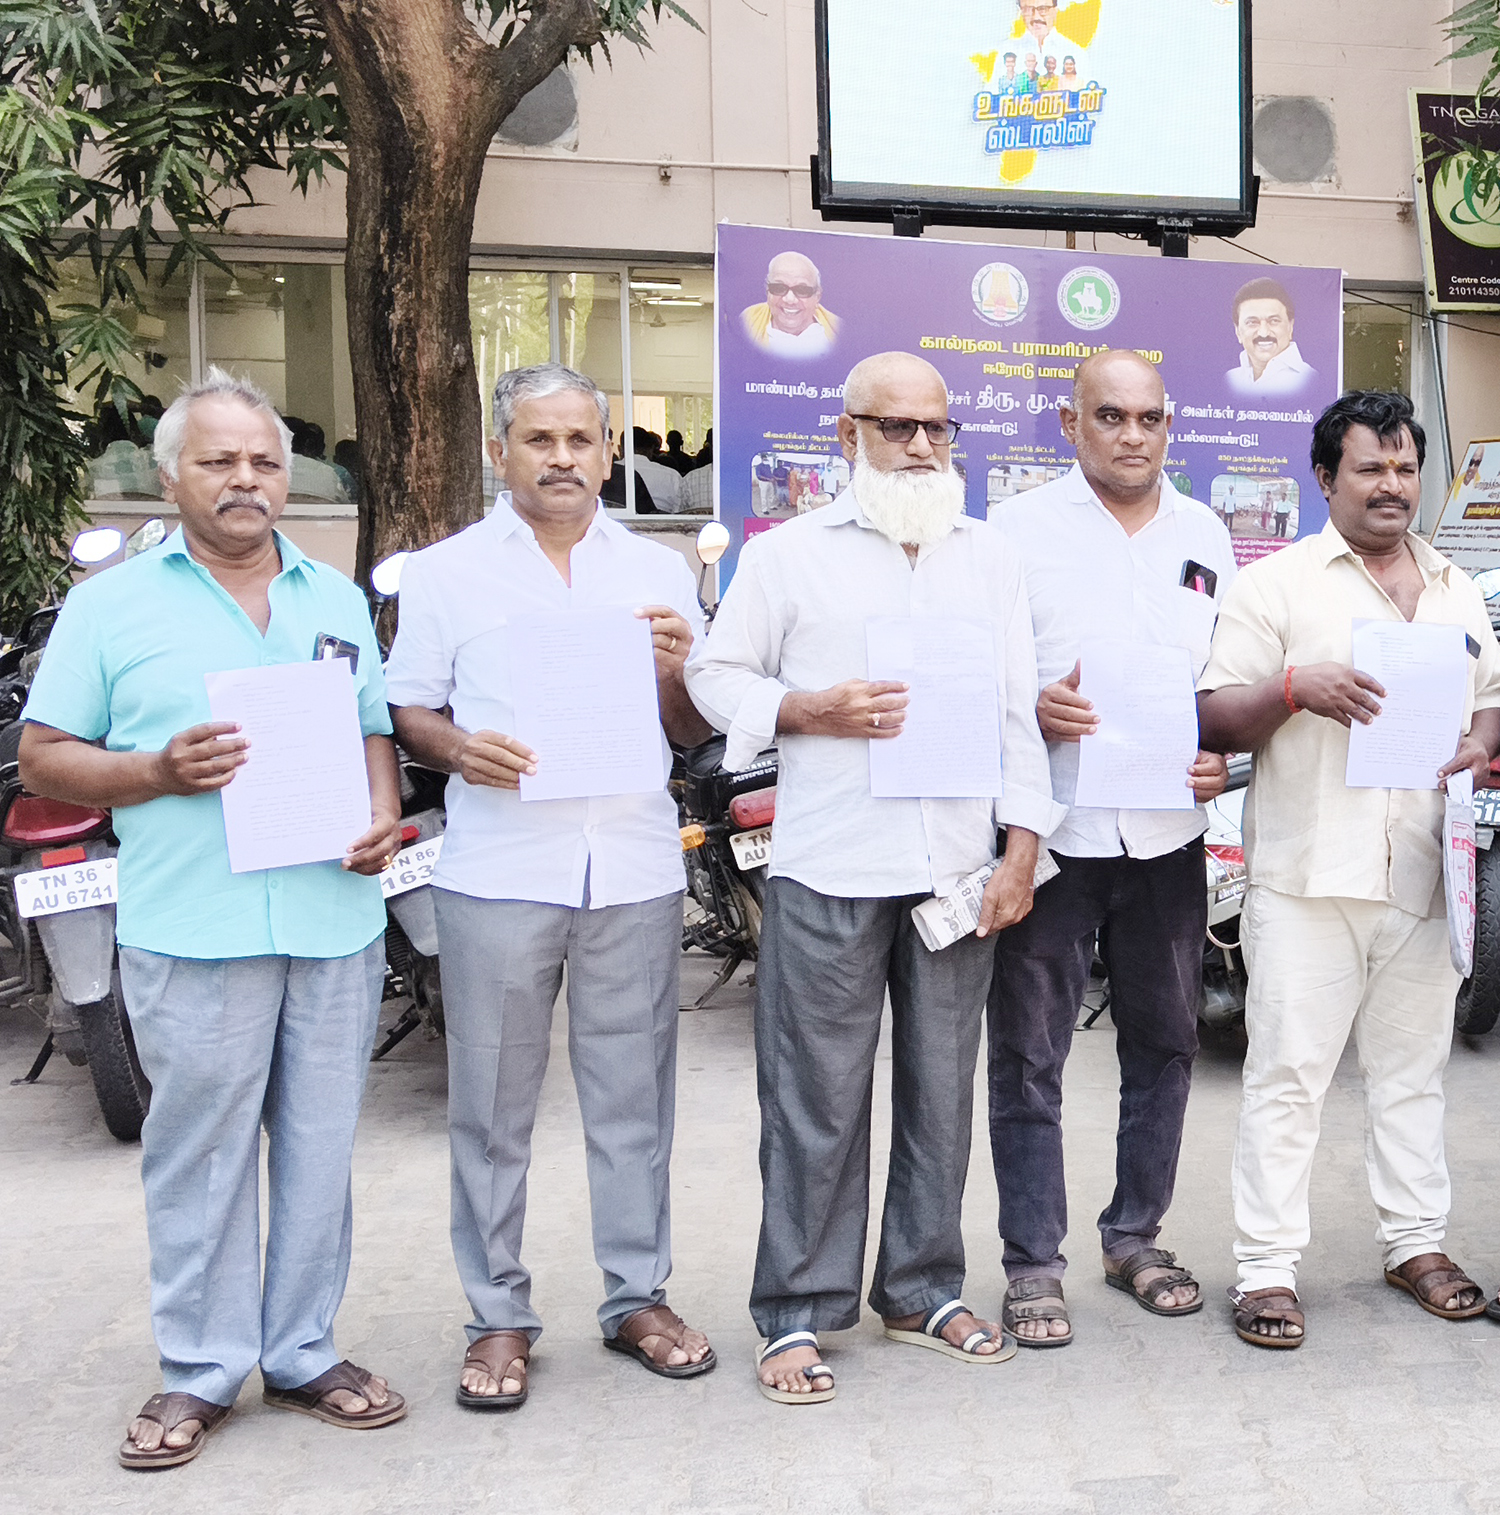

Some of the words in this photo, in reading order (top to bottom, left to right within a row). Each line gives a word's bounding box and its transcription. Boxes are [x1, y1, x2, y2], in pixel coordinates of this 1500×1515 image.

[976, 83, 1104, 120] உங்களுடன்
[988, 114, 1094, 150] ஸ்டாலின்
[1451, 276, 1479, 285] Centre
[919, 334, 1009, 356] கால்நடை
[983, 361, 1035, 380] ஈரோடு
[744, 379, 818, 398] மாண்புமிகு
[1180, 403, 1234, 420] அவர்கள்
[1235, 409, 1315, 424] தலைமையில்
[1177, 430, 1260, 448] பல்லாண்டு!!
[748, 831, 772, 847] TN
[415, 848, 435, 862] 86
[744, 847, 767, 864] AU
[38, 873, 68, 890] TN
[73, 868, 98, 884] 36
[32, 893, 60, 911] AU
[66, 884, 113, 905] 6741
